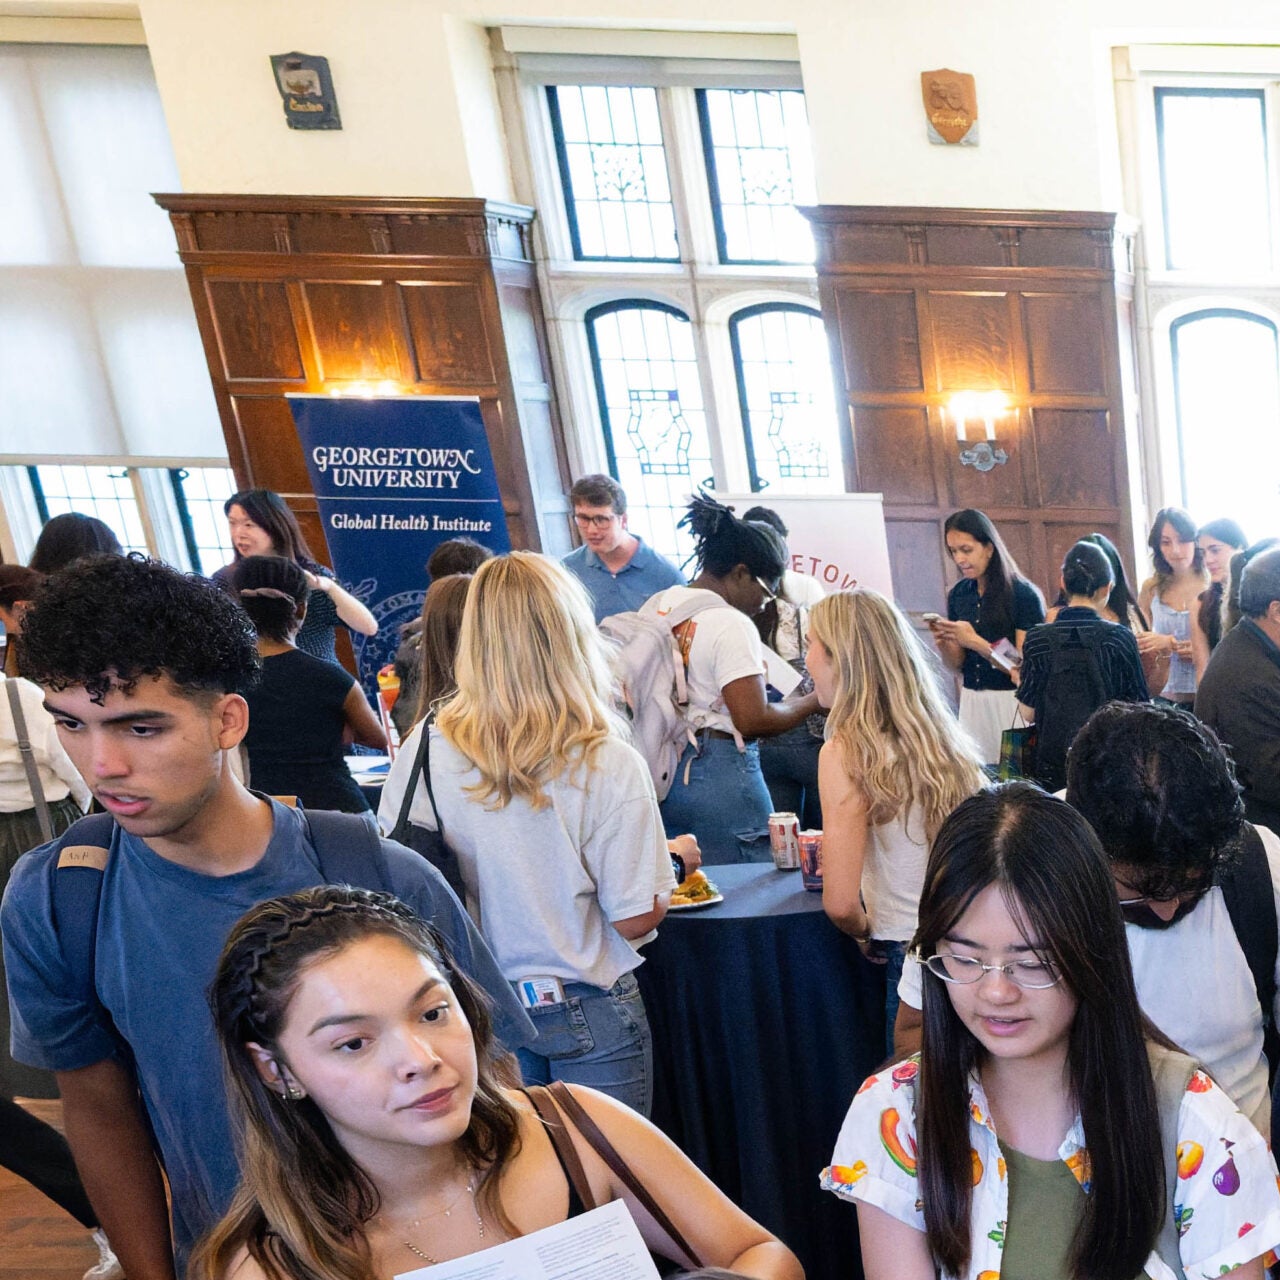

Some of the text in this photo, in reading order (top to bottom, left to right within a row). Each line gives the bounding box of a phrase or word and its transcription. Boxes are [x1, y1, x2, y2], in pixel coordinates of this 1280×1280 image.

[312, 447, 481, 473] GEORGETOWN
[333, 468, 461, 488] UNIVERSITY
[331, 513, 492, 532] Global Health Institute
